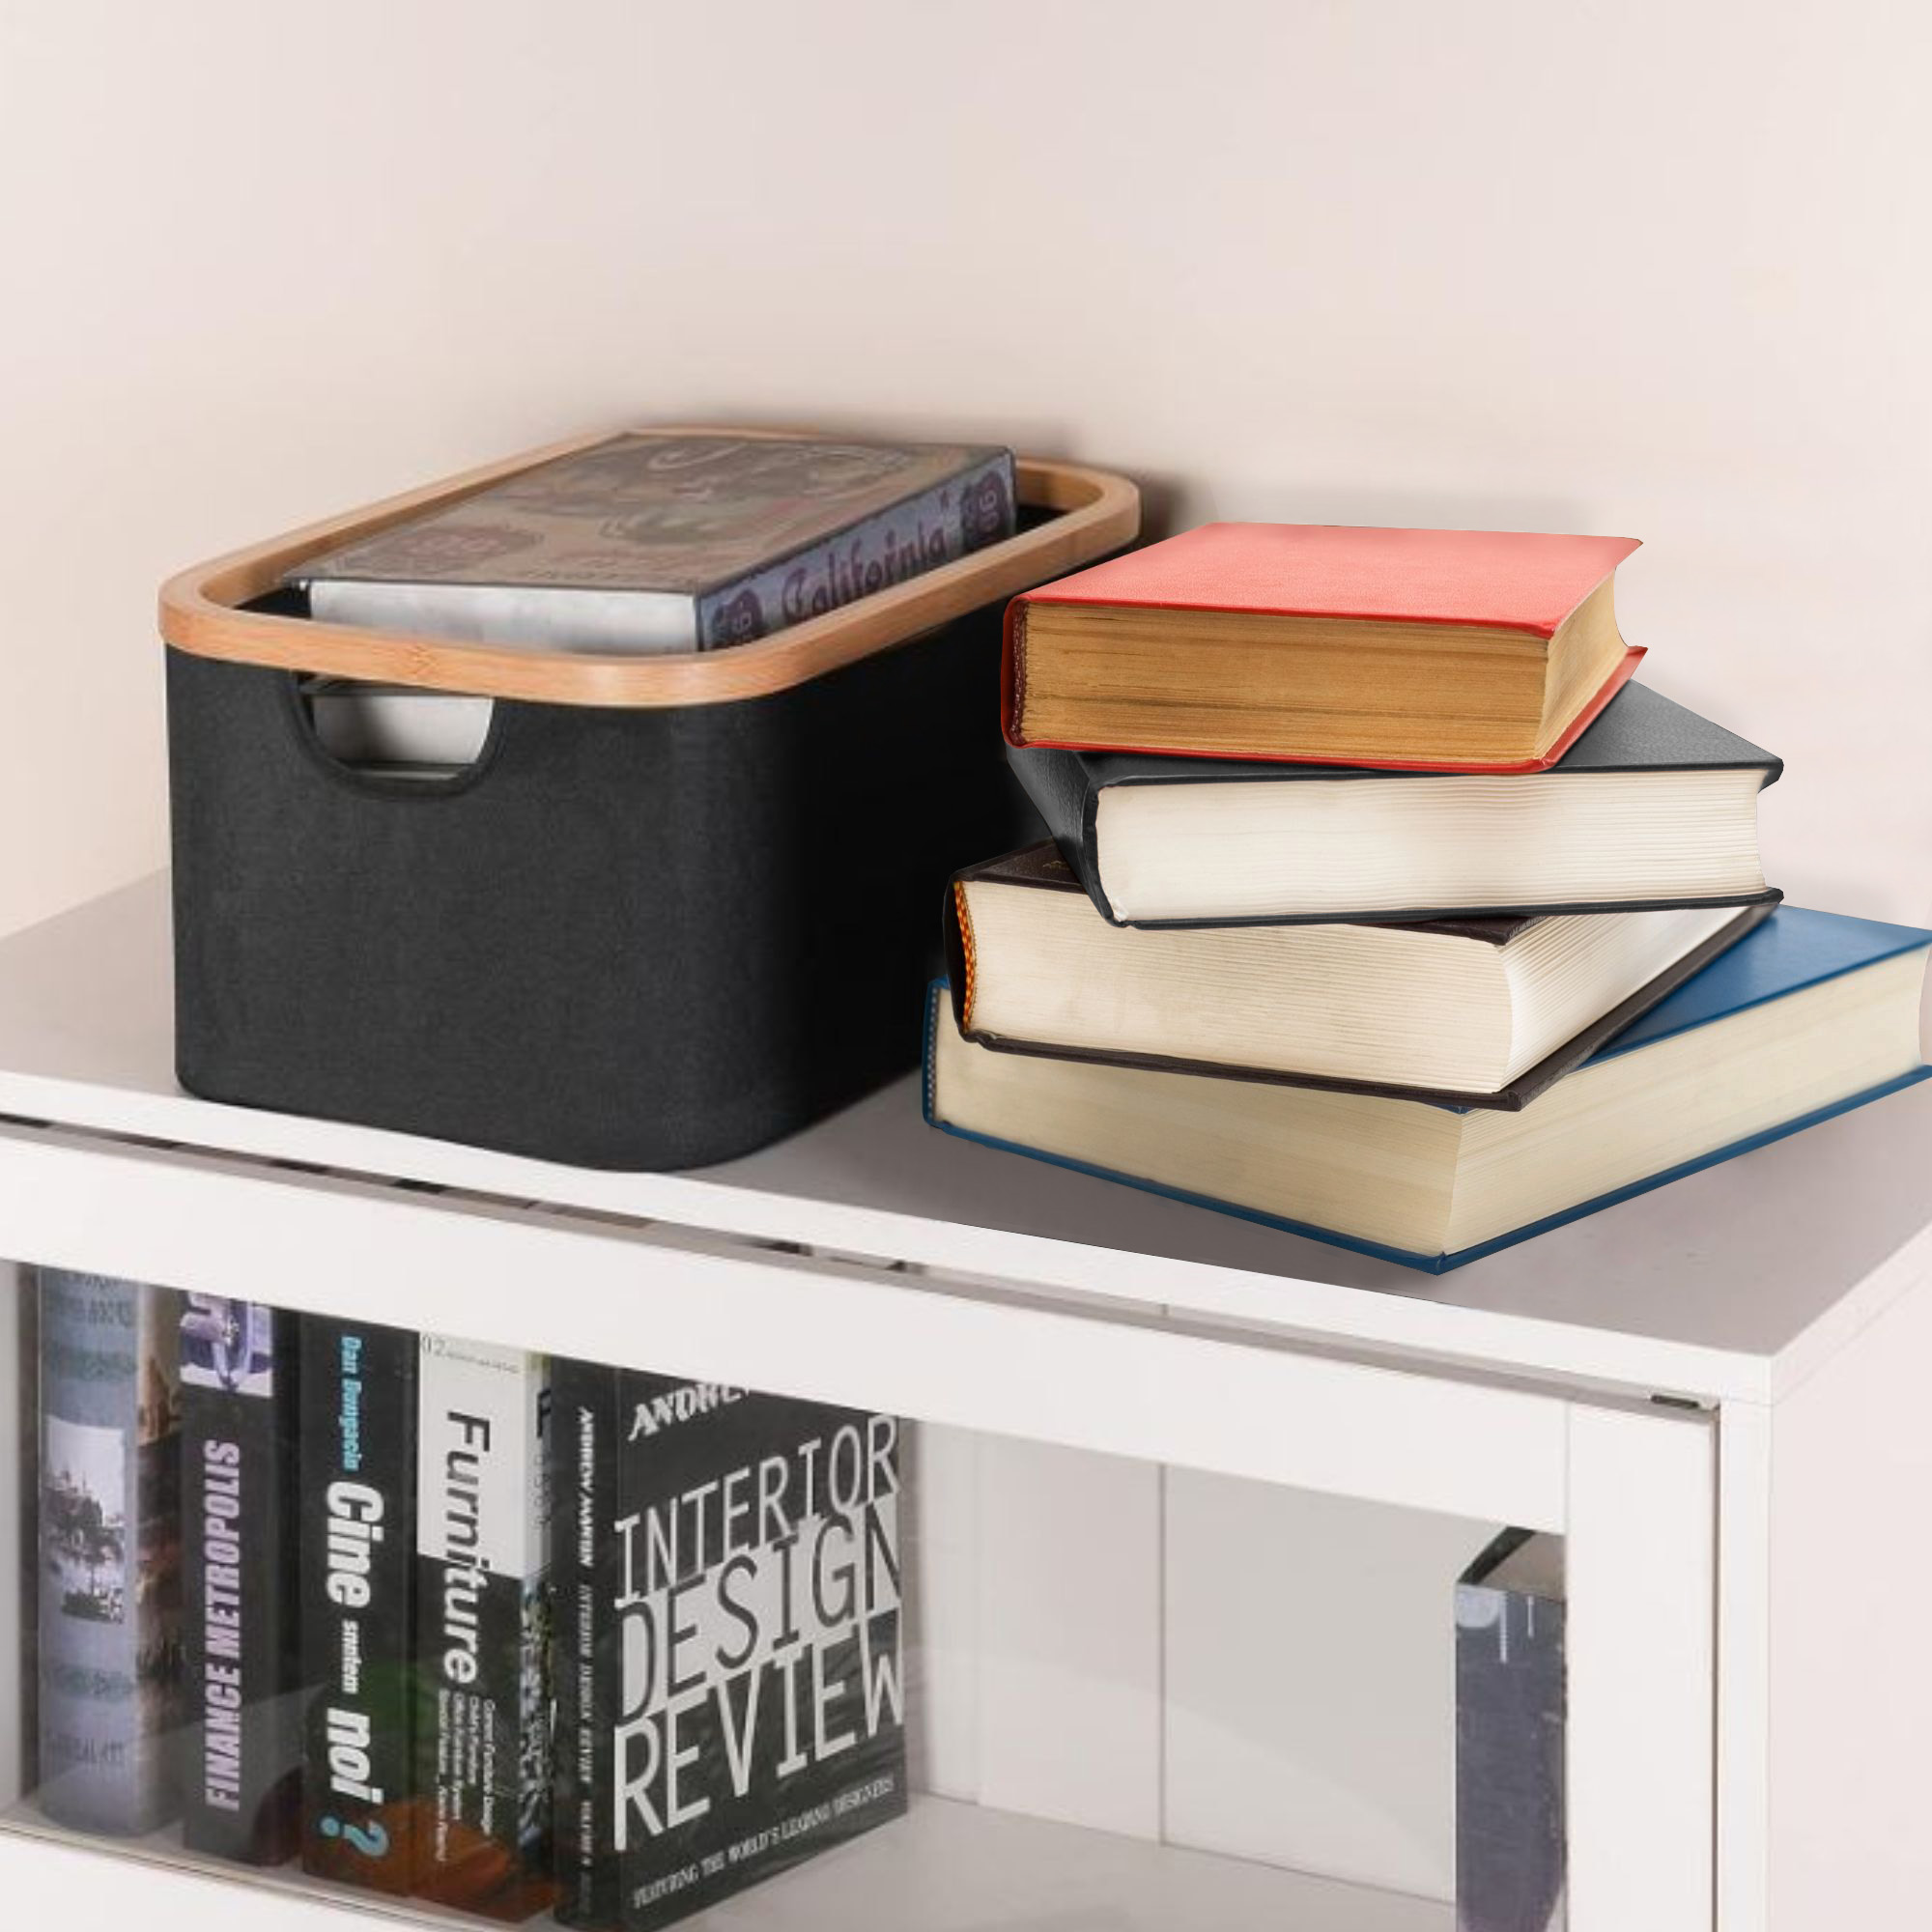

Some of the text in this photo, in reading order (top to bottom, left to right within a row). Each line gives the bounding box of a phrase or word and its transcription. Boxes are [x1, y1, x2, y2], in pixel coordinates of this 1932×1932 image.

[204, 1439, 241, 1811] FINANCE METROPOLIS
[326, 1481, 385, 1607] Cine
[444, 1409, 491, 1685] Furniture
[612, 1414, 900, 1608] INTERIOR
[620, 1493, 900, 1727] DESIGN
[327, 1708, 384, 1804] noi
[612, 1609, 901, 1851] REVIEW
